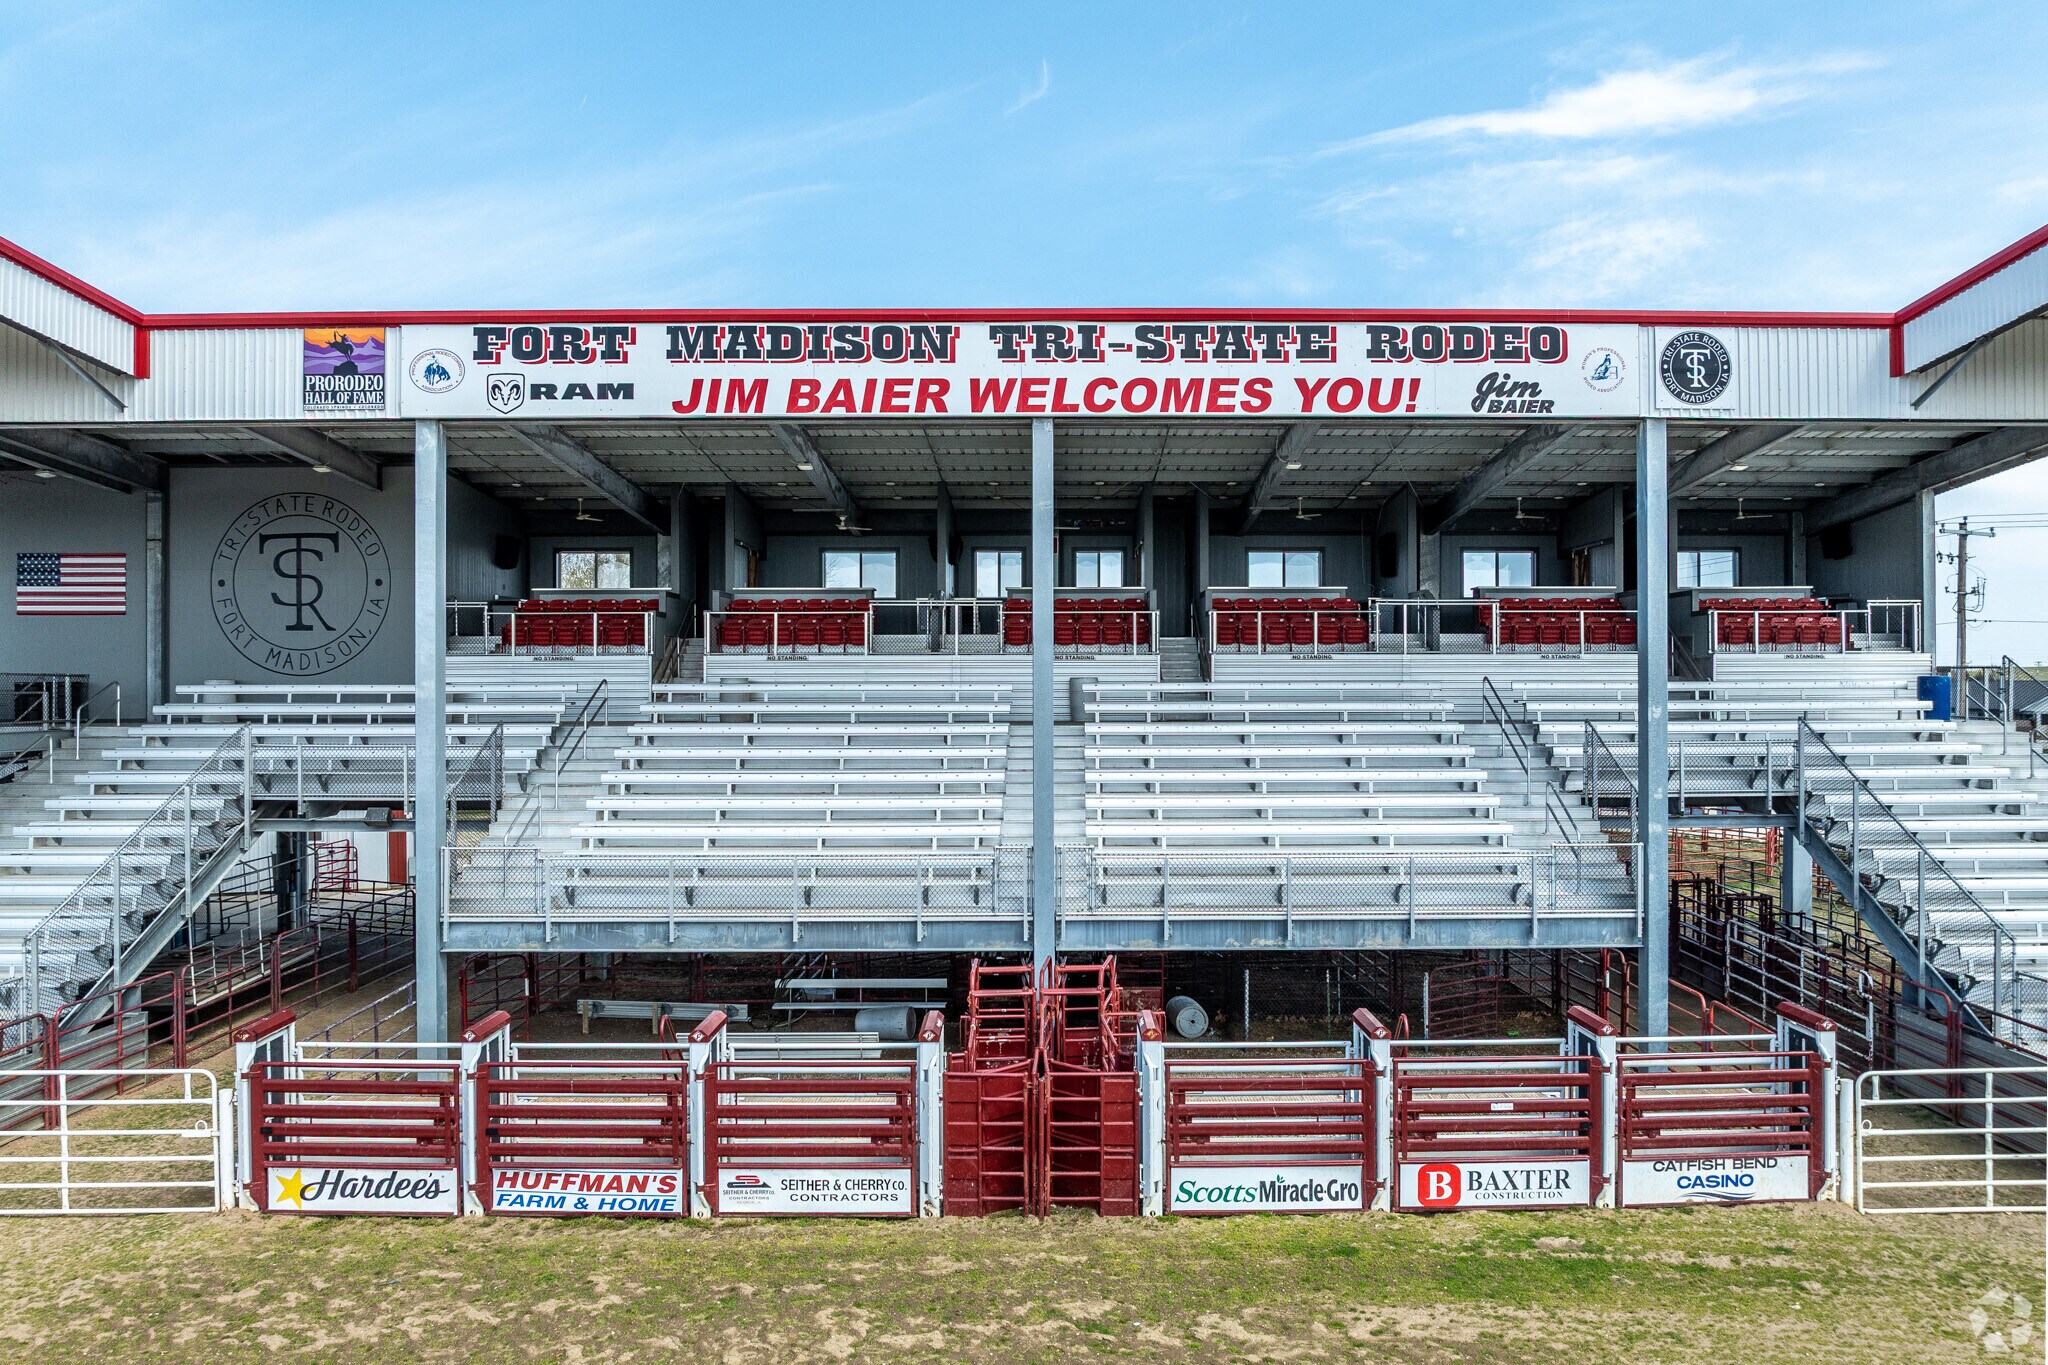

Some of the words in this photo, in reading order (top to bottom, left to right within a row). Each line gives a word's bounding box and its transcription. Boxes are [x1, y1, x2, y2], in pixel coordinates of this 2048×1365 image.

[472, 326, 637, 364] FORT
[666, 325, 960, 363] MADISON
[988, 325, 1337, 363] TRI-STATE
[1366, 325, 1568, 364] RODEO
[1663, 333, 1700, 361] TRI-STATE
[1702, 335, 1728, 362] RODEO
[304, 374, 384, 392] PRORODEO
[529, 382, 635, 400] RAM
[1471, 371, 1543, 413] Jim
[1663, 372, 1681, 395] FORT
[1720, 373, 1730, 383] IA
[304, 391, 335, 404] HALL
[336, 391, 352, 404] OF
[352, 391, 384, 404] FAME
[671, 378, 769, 415] JIM
[785, 378, 951, 414] BAIER
[968, 377, 1273, 414] WELCOMES
[1293, 377, 1421, 414] YOU!
[1487, 399, 1555, 414] BAIER
[218, 495, 315, 561] TRI-STATE
[322, 500, 381, 557] RODEO
[216, 597, 258, 649] FORT
[366, 598, 385, 617] IA
[1652, 1158, 1726, 1172] CATFISH
[1732, 1157, 1778, 1170] BEND
[299, 1169, 451, 1201] Hardee's
[496, 1171, 677, 1194] HUFFMAN'S
[780, 1178, 830, 1191] SEITHER
[833, 1179, 842, 1191] &
[845, 1178, 891, 1191] CHERRY
[1174, 1179, 1258, 1203] Scotts
[1425, 1171, 1453, 1200] B
[1467, 1169, 1571, 1191] BAXTER
[1676, 1174, 1754, 1189] CASINO
[496, 1193, 567, 1209] FARM
[573, 1197, 589, 1210] &
[598, 1197, 677, 1211] HOME
[789, 1193, 899, 1202] CONTRACTORS
[1474, 1191, 1564, 1200] CONSTRUCTION
